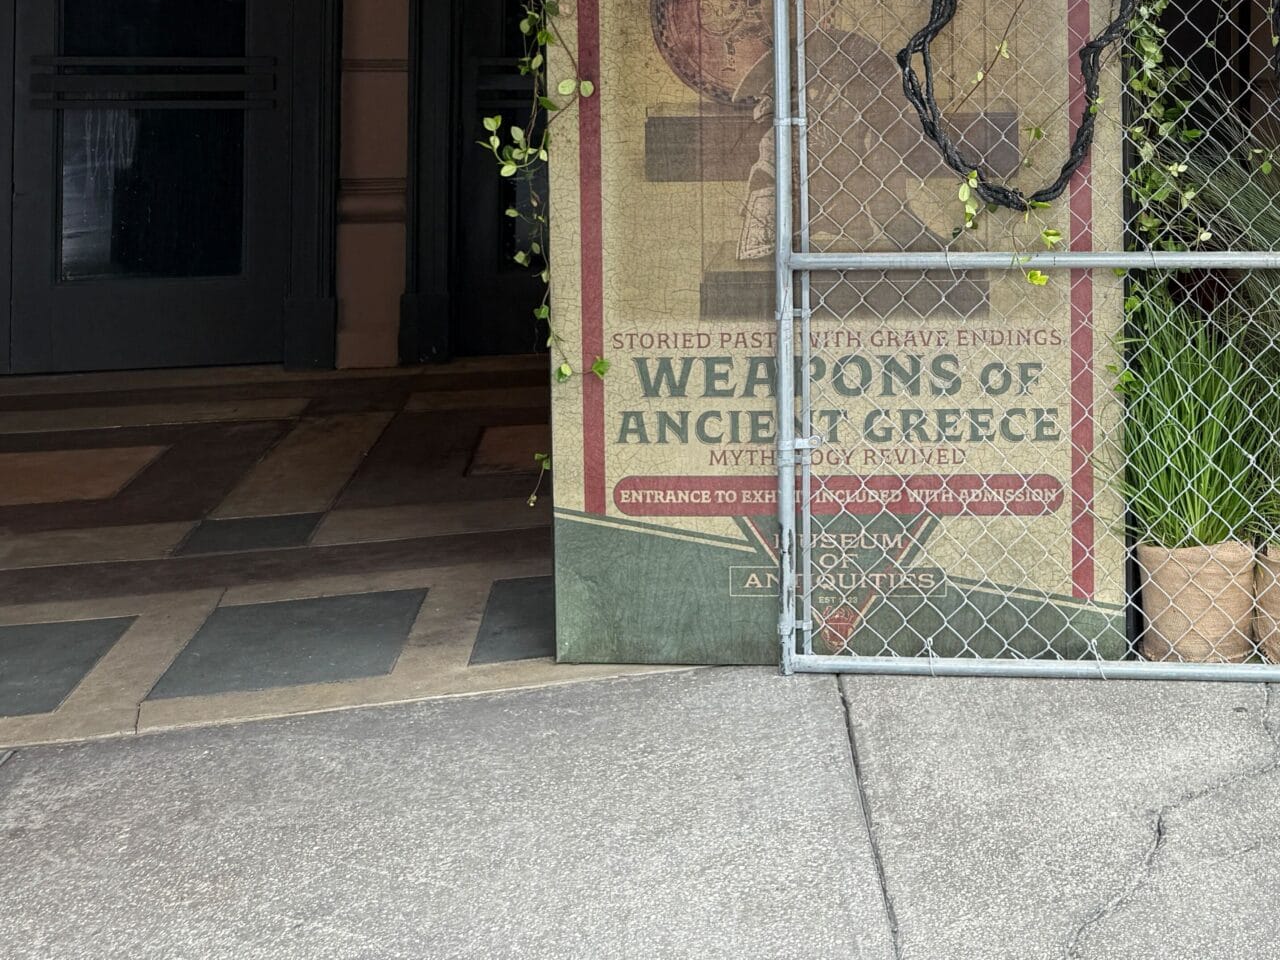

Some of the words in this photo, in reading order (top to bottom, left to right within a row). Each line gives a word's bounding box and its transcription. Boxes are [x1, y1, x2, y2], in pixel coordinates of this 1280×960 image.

[612, 331, 712, 350] STORIED
[805, 329, 862, 348] WITH
[869, 329, 950, 348] GRAVE
[957, 328, 1063, 347] ENDINGS
[632, 352, 963, 400] WEAPONS
[979, 361, 1048, 396] OF
[862, 406, 1064, 444] GREECE
[708, 449, 855, 467] MYTHOGY
[863, 448, 968, 466] REVIVED
[619, 489, 712, 504] ENTRANCE
[713, 489, 738, 504] TO
[814, 487, 902, 503] INCLUDED
[905, 487, 954, 503] WITH
[958, 487, 1058, 503] ADMISSION
[773, 532, 904, 549] USEUM
[819, 552, 859, 570] OF
[743, 572, 936, 592] ANTQUITIES
